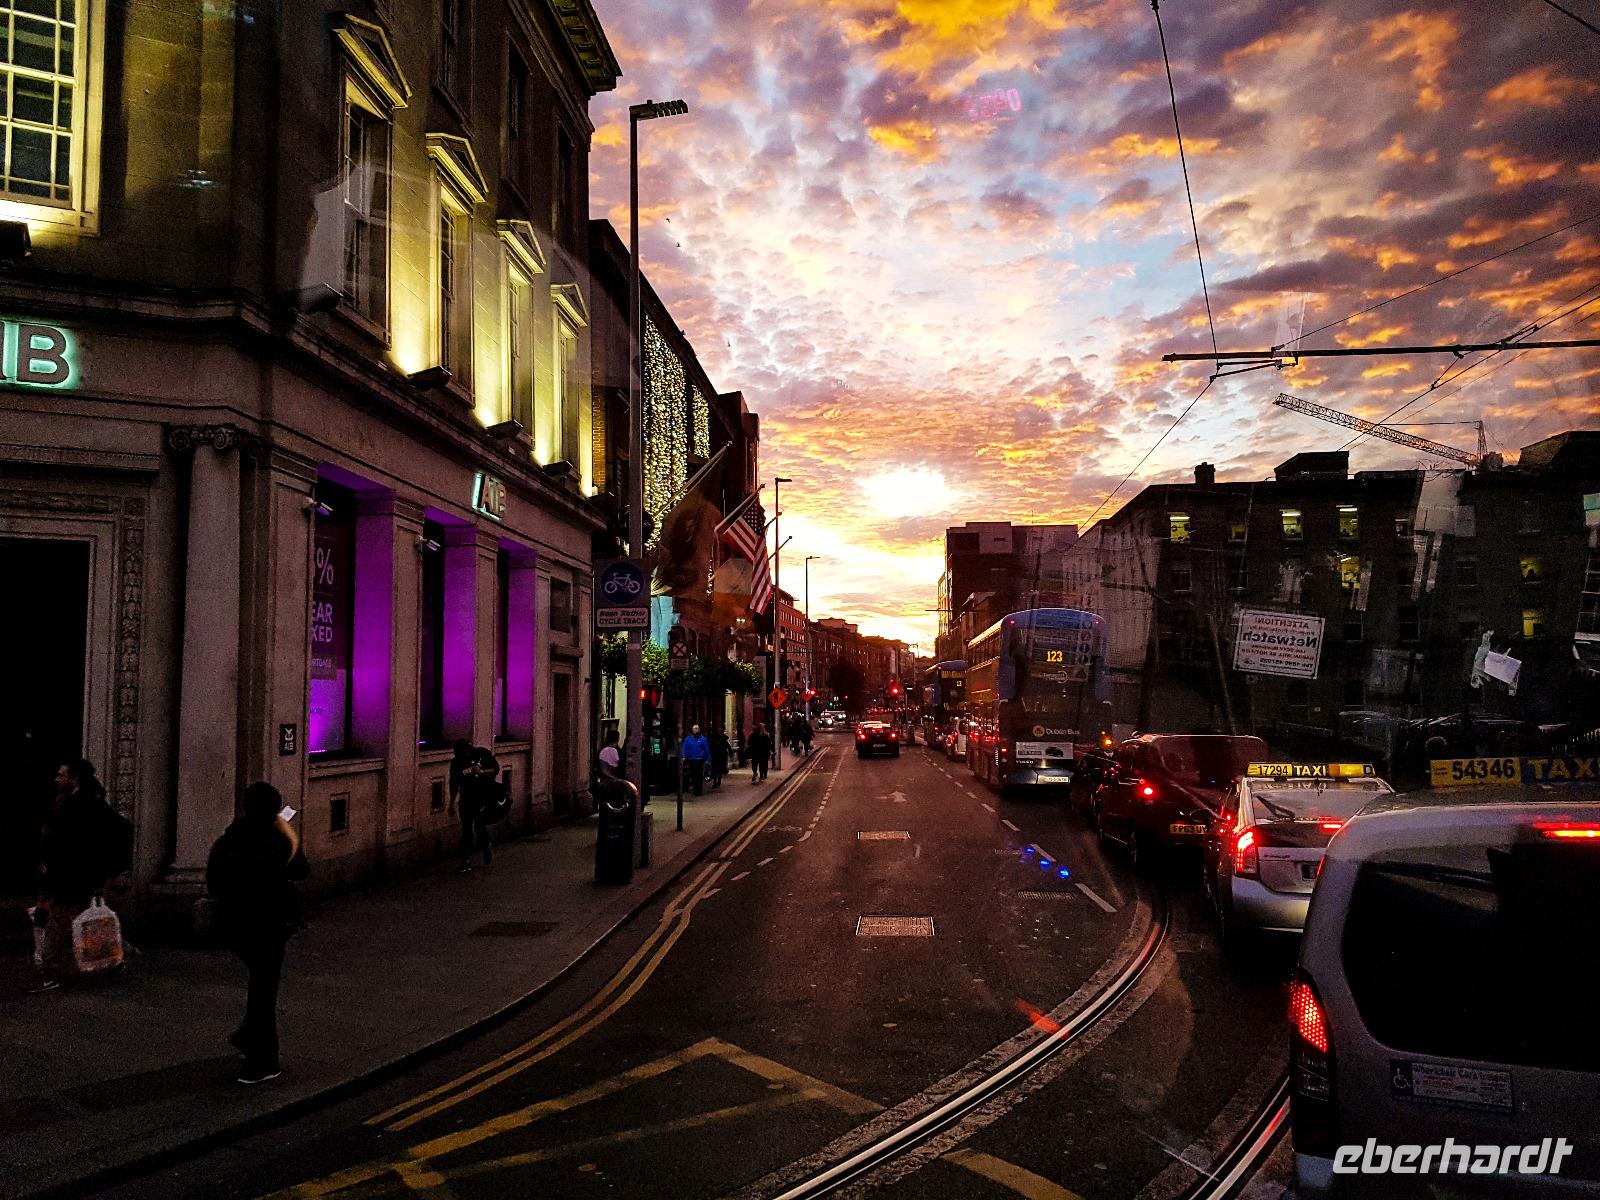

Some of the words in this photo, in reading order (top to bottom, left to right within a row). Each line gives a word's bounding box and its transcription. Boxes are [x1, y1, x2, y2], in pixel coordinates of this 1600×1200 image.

[1046, 650, 1063, 662] 123
[1258, 765, 1289, 776] 17294
[1294, 765, 1327, 776] TAXI
[1452, 758, 1515, 780] 54346
[1527, 758, 1600, 780] TAX
